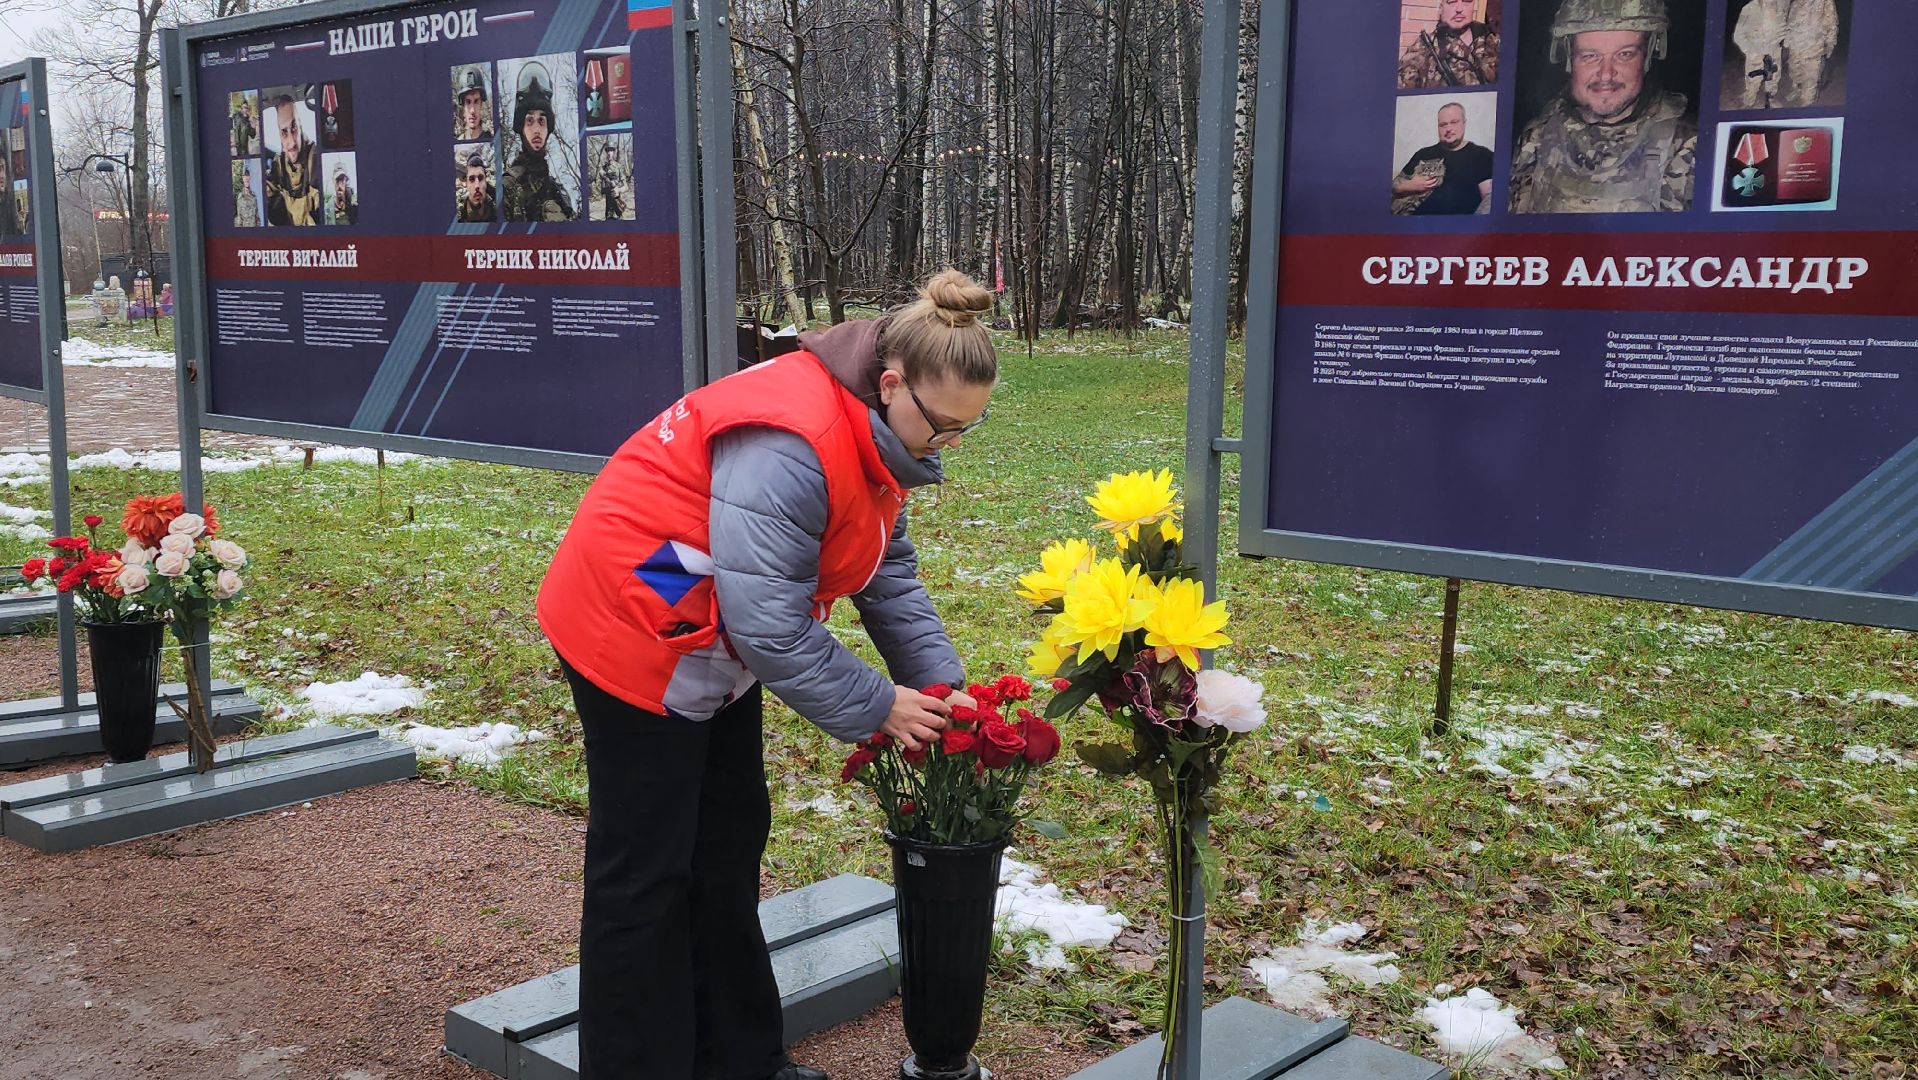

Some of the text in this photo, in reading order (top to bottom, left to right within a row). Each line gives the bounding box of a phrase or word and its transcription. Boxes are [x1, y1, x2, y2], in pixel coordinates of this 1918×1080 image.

[328, 8, 478, 56] НАШИ ГЕРОИ
[238, 244, 358, 268] ТЕРНИК ВИТАЛИЙ
[465, 243, 630, 270] ТЕРНИК НИКОЛАЙ
[1362, 256, 1868, 294] СЕРГЕЕВ АЛЕКСАНДР
